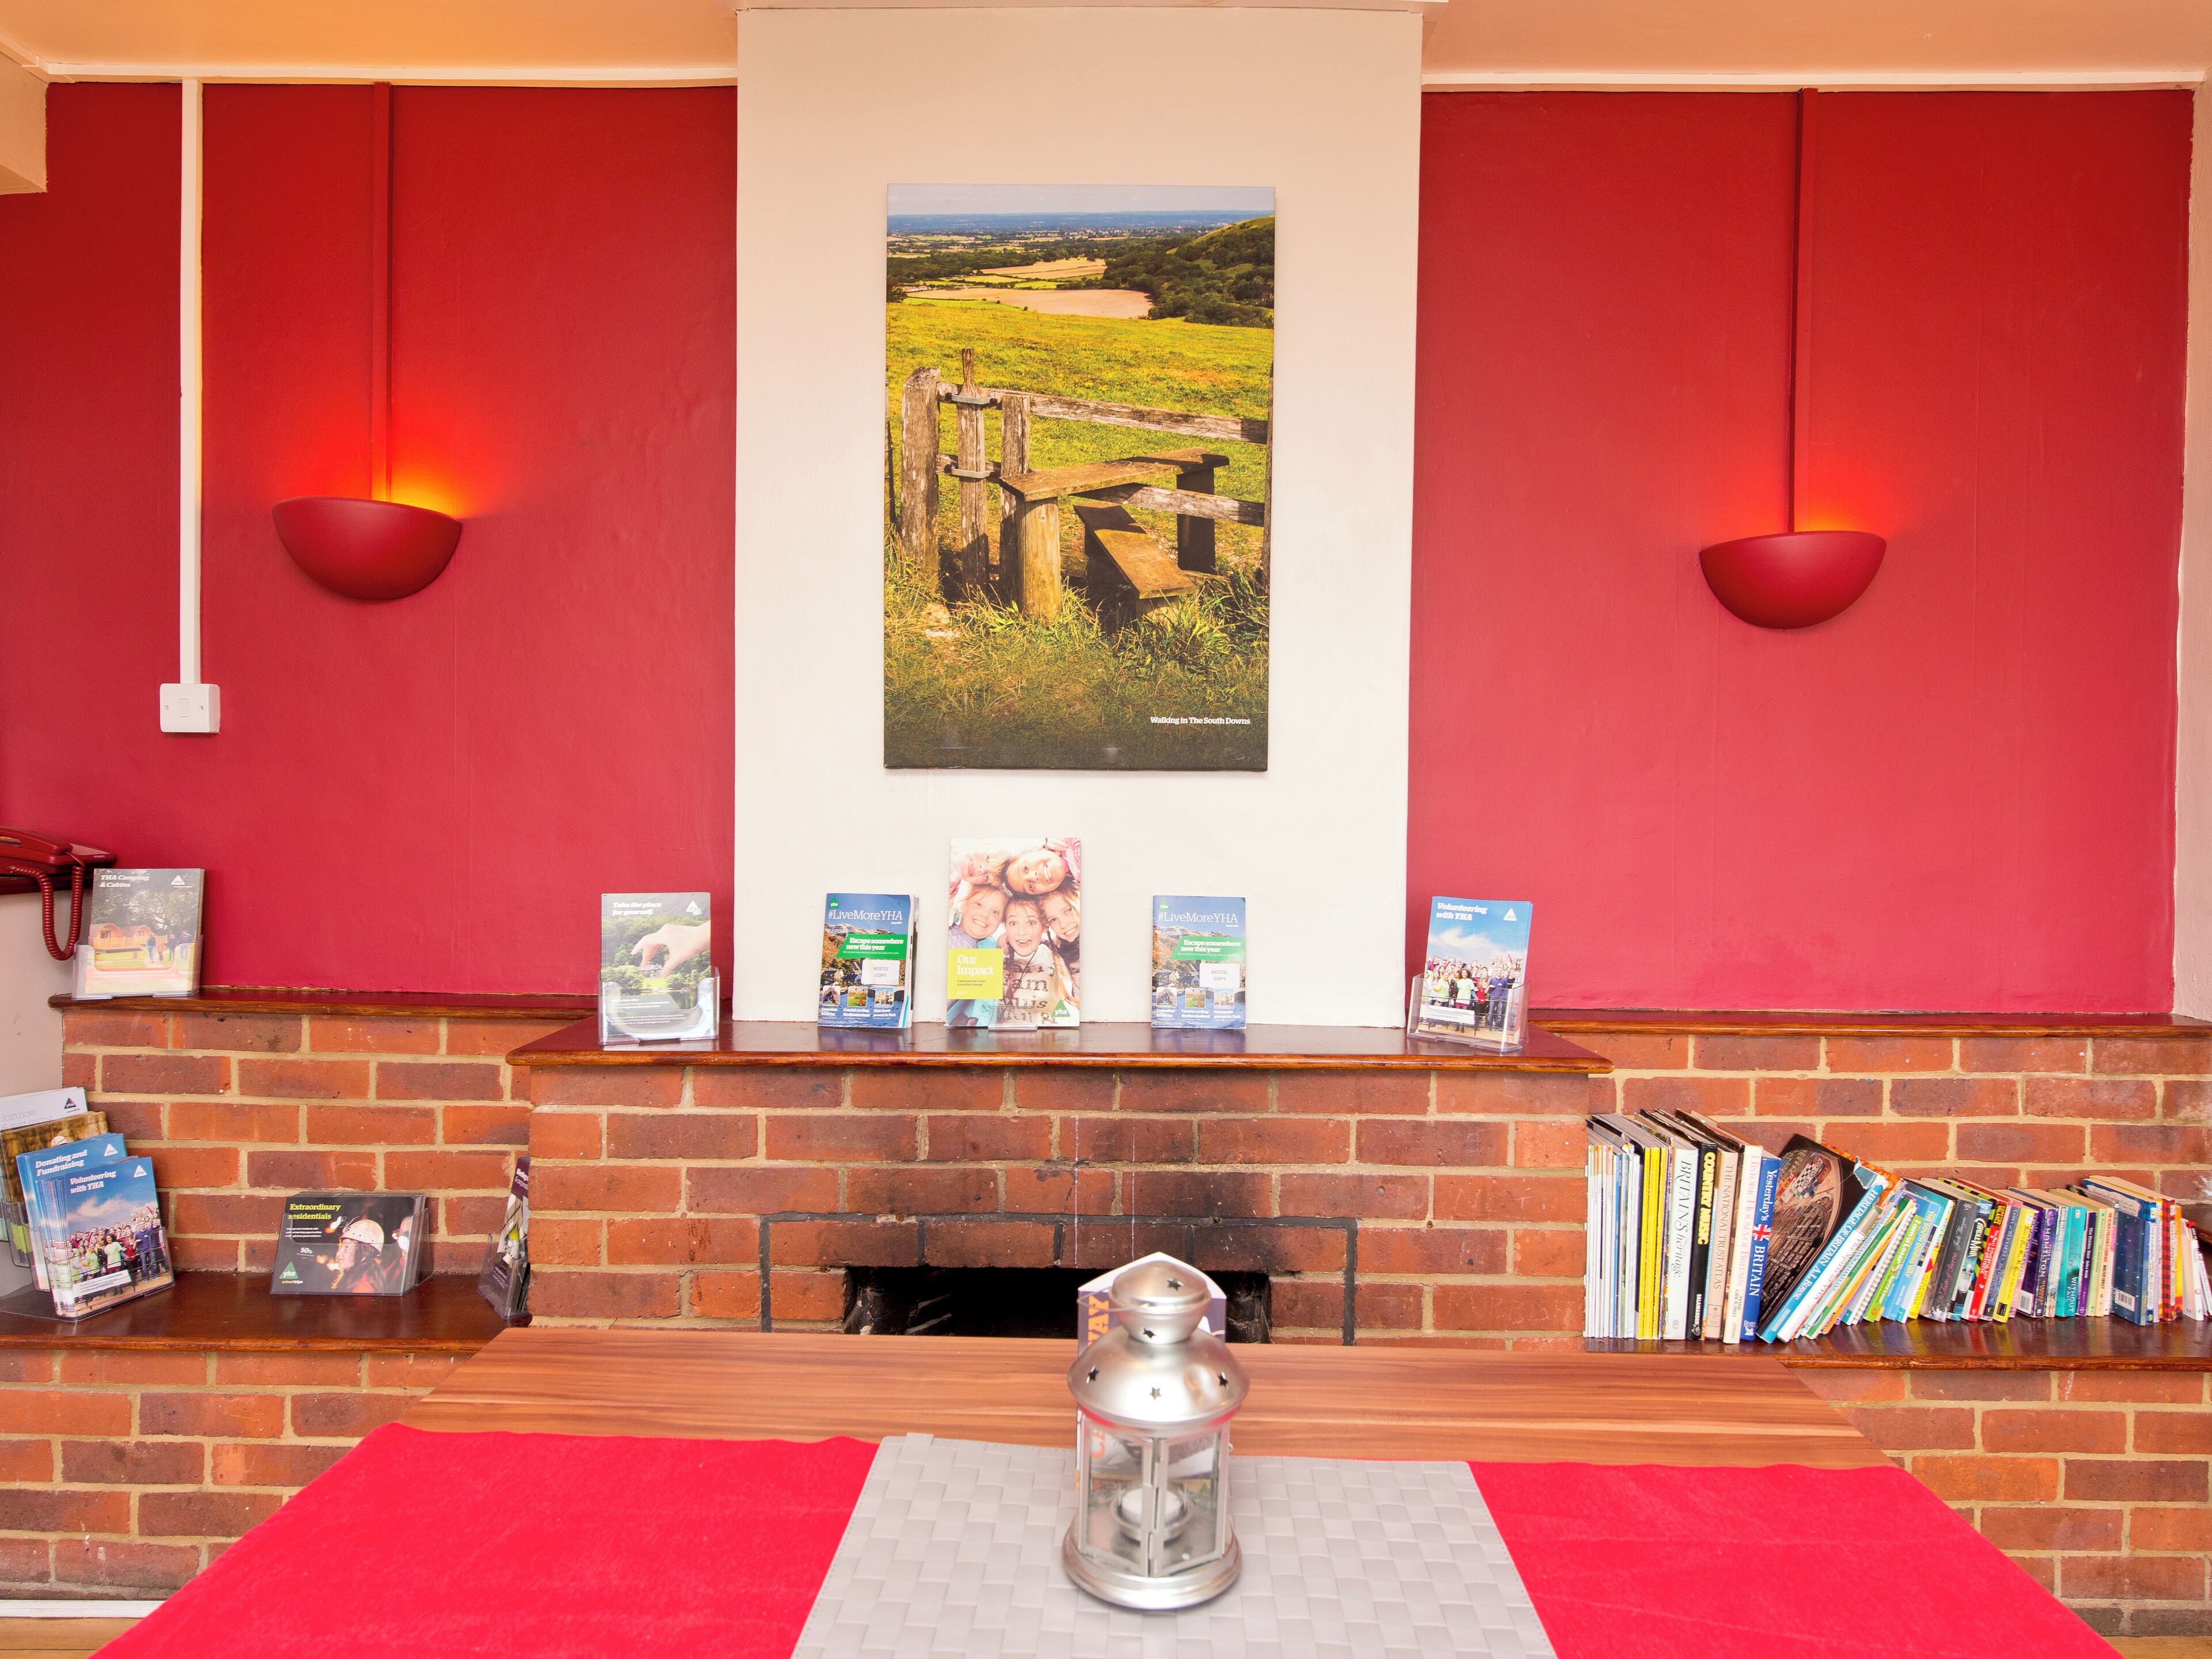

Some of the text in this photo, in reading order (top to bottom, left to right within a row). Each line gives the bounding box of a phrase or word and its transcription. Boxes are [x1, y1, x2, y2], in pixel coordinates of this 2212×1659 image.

[1150, 717, 1180, 725] Walking
[828, 910, 903, 921] #LiveMoreYHA
[1158, 912, 1238, 923] #LiveMoreYHA
[1436, 911, 1454, 919] with
[1437, 902, 1488, 915] Volunteering
[957, 955, 977, 964] Our
[957, 965, 994, 977] Impact
[18, 1109, 36, 1118] now
[35, 1150, 87, 1168] Donating and
[37, 1160, 84, 1176] Fundraising
[70, 1171, 117, 1185] Volunteering
[70, 1181, 104, 1194] with YHA
[1697, 1152, 1716, 1245] COUNTRY MUSIC
[1760, 1169, 1778, 1222] Yesterday's
[1846, 1188, 1878, 1226] HERITAGE
[1925, 1210, 1934, 1222] THE
[1993, 1205, 2002, 1224] VALANCE
[1997, 1205, 2006, 1225] COMPTON
[1713, 1164, 1733, 1290] THE NATIONAL TRUST ATLAS
[1741, 1199, 1754, 1236] HOUSES
[1839, 1224, 1851, 1236] OF
[1907, 1222, 1918, 1237] am
[1917, 1221, 1930, 1243] SOUTH
[1817, 1234, 1845, 1266] BRITAIN
[1895, 1243, 1910, 1264] Loser
[1909, 1241, 1922, 1264] DOWNS
[2039, 1228, 2050, 1277] HAMILTON
[2067, 1228, 2076, 1266] CHILD
[1736, 1250, 1749, 1286] BRITAIN
[1831, 1250, 1851, 1274] Spirit
[1980, 1252, 1989, 1274] UNIVERSE
[1985, 1247, 1994, 1269] POWERFUL
[1748, 1245, 1766, 1296] BRITAIN
[1904, 1263, 1913, 1278] WAY
[1792, 1278, 1812, 1301] Rowse
[2067, 1277, 2077, 1312] WITHOUT
